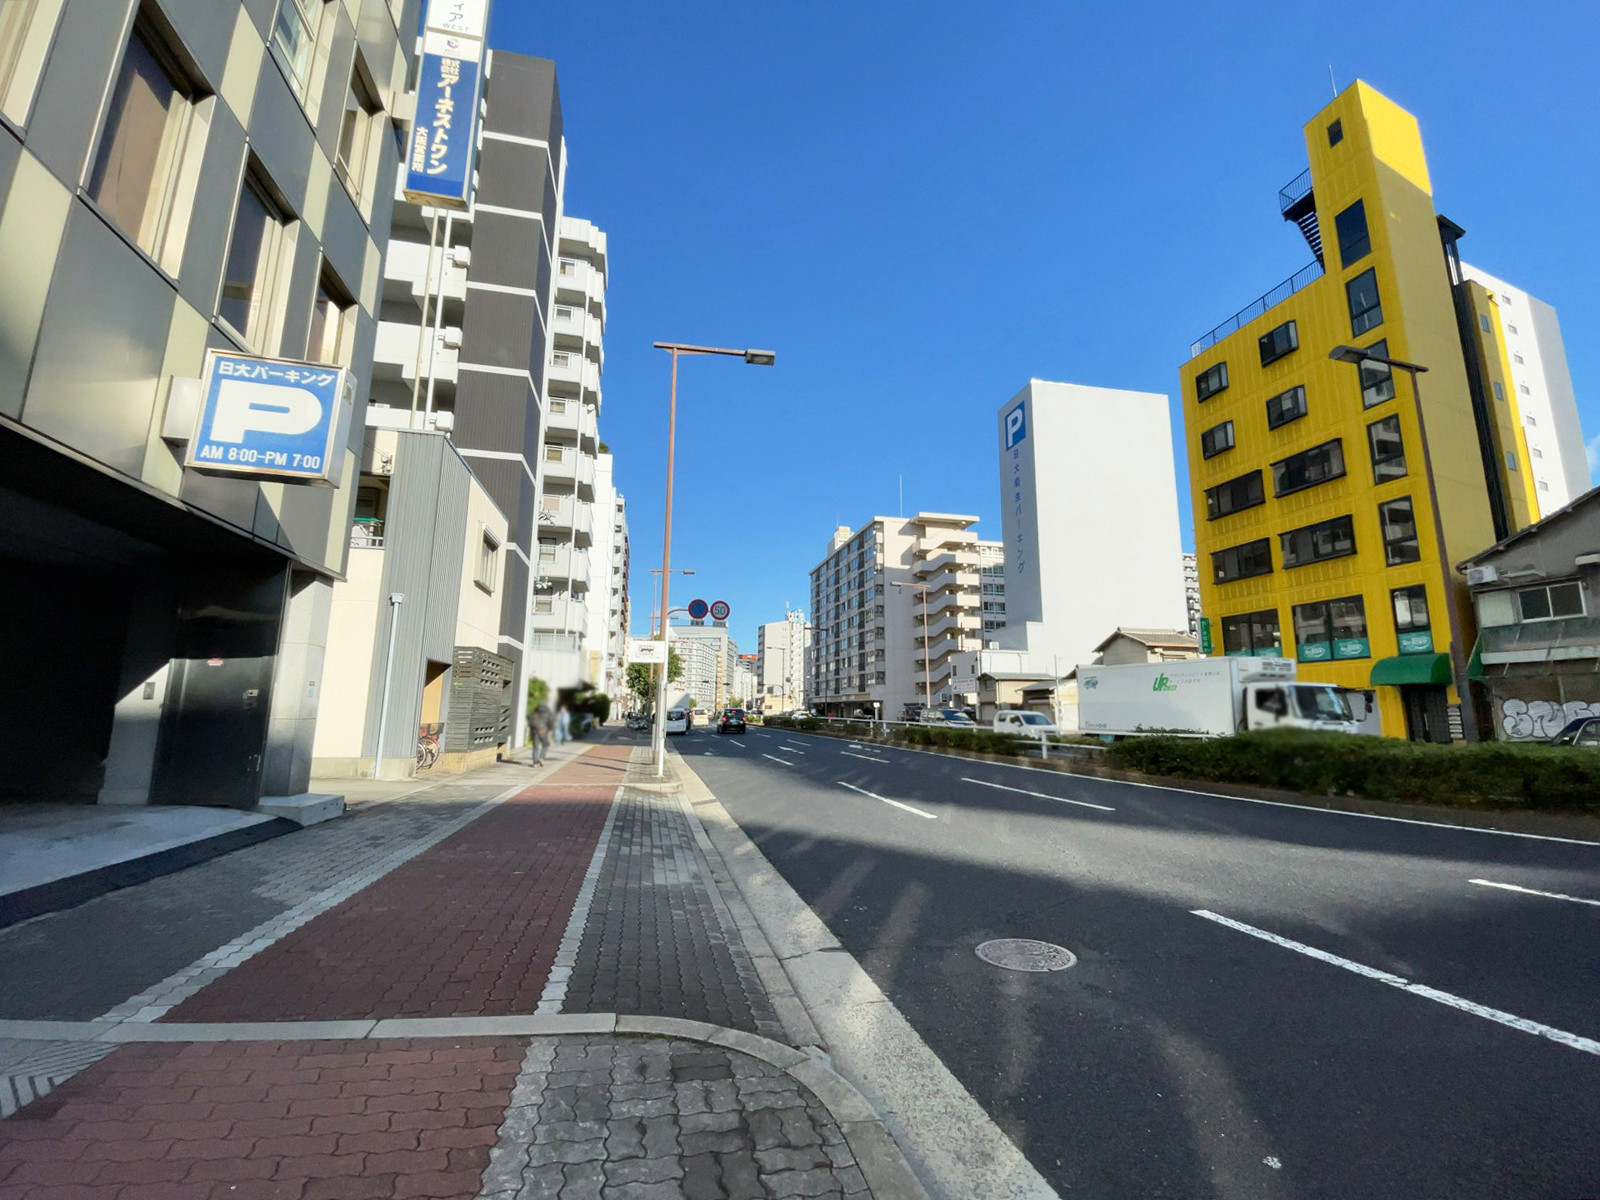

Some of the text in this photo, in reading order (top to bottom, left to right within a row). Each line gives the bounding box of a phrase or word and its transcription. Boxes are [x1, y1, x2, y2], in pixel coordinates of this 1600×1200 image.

[443, 22, 469, 32] WEST
[218, 361, 336, 387] 日大パーキング
[210, 379, 323, 444] P
[1007, 408, 1023, 448] P
[201, 445, 223, 459] AM
[714, 605, 726, 616] 50
